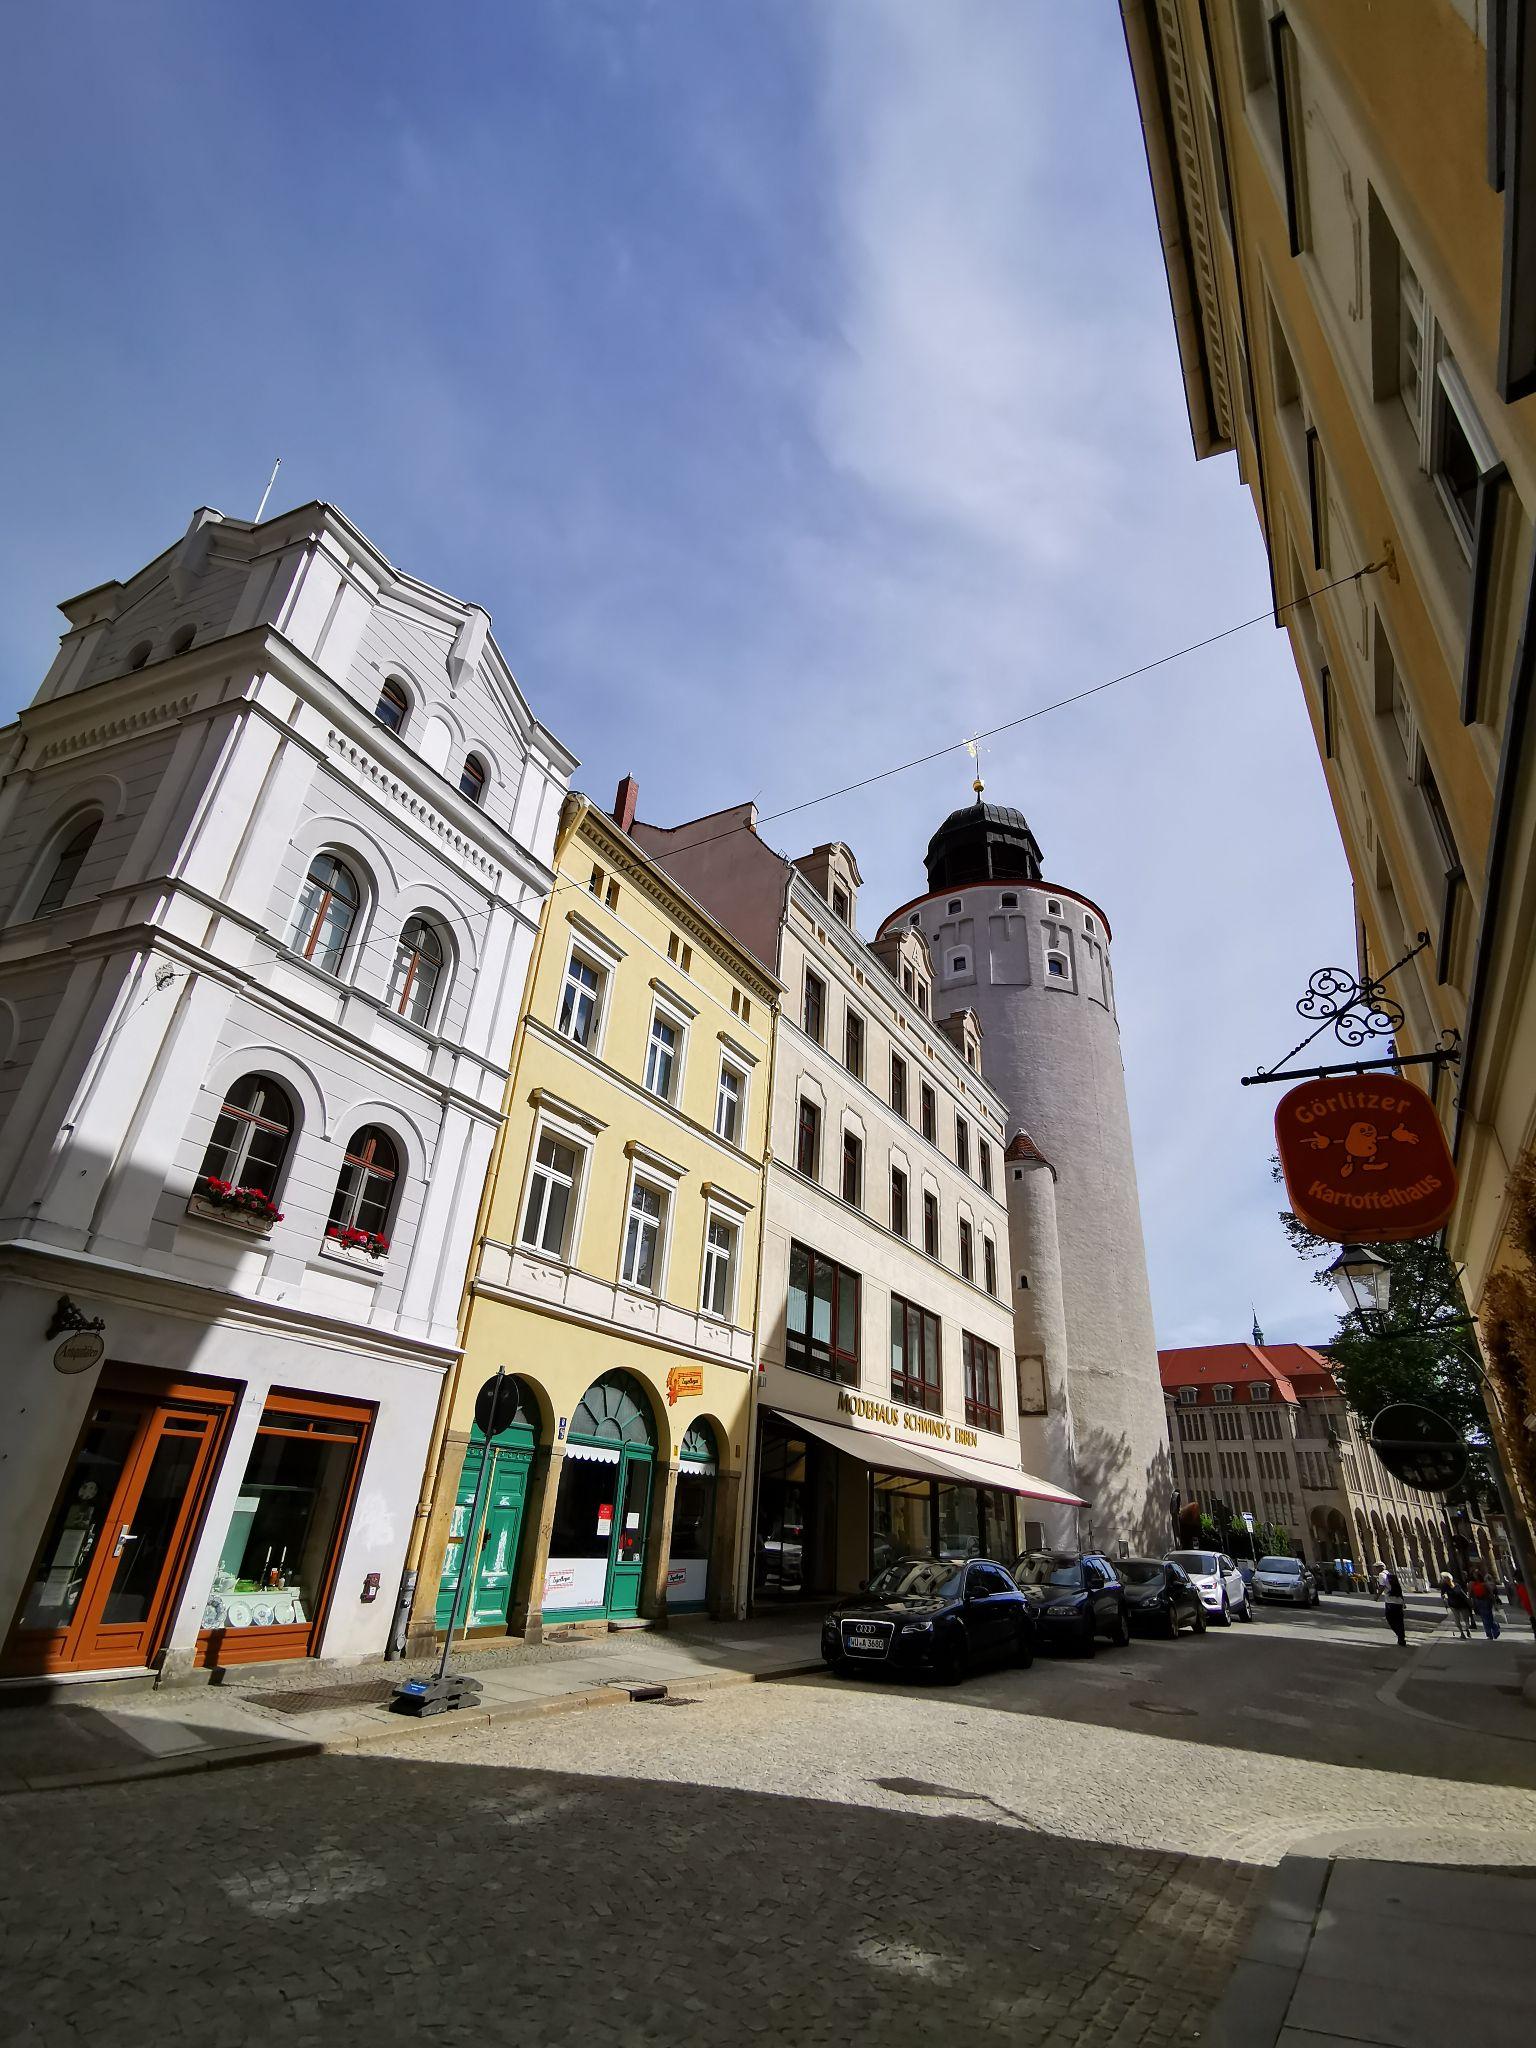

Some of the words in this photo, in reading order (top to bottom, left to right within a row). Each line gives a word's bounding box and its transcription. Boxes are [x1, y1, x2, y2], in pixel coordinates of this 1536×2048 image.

[1296, 1092, 1411, 1123] Görlitzer
[1308, 1174, 1442, 1209] Kartoffelhaus
[837, 1391, 899, 1427] MODEHAUS
